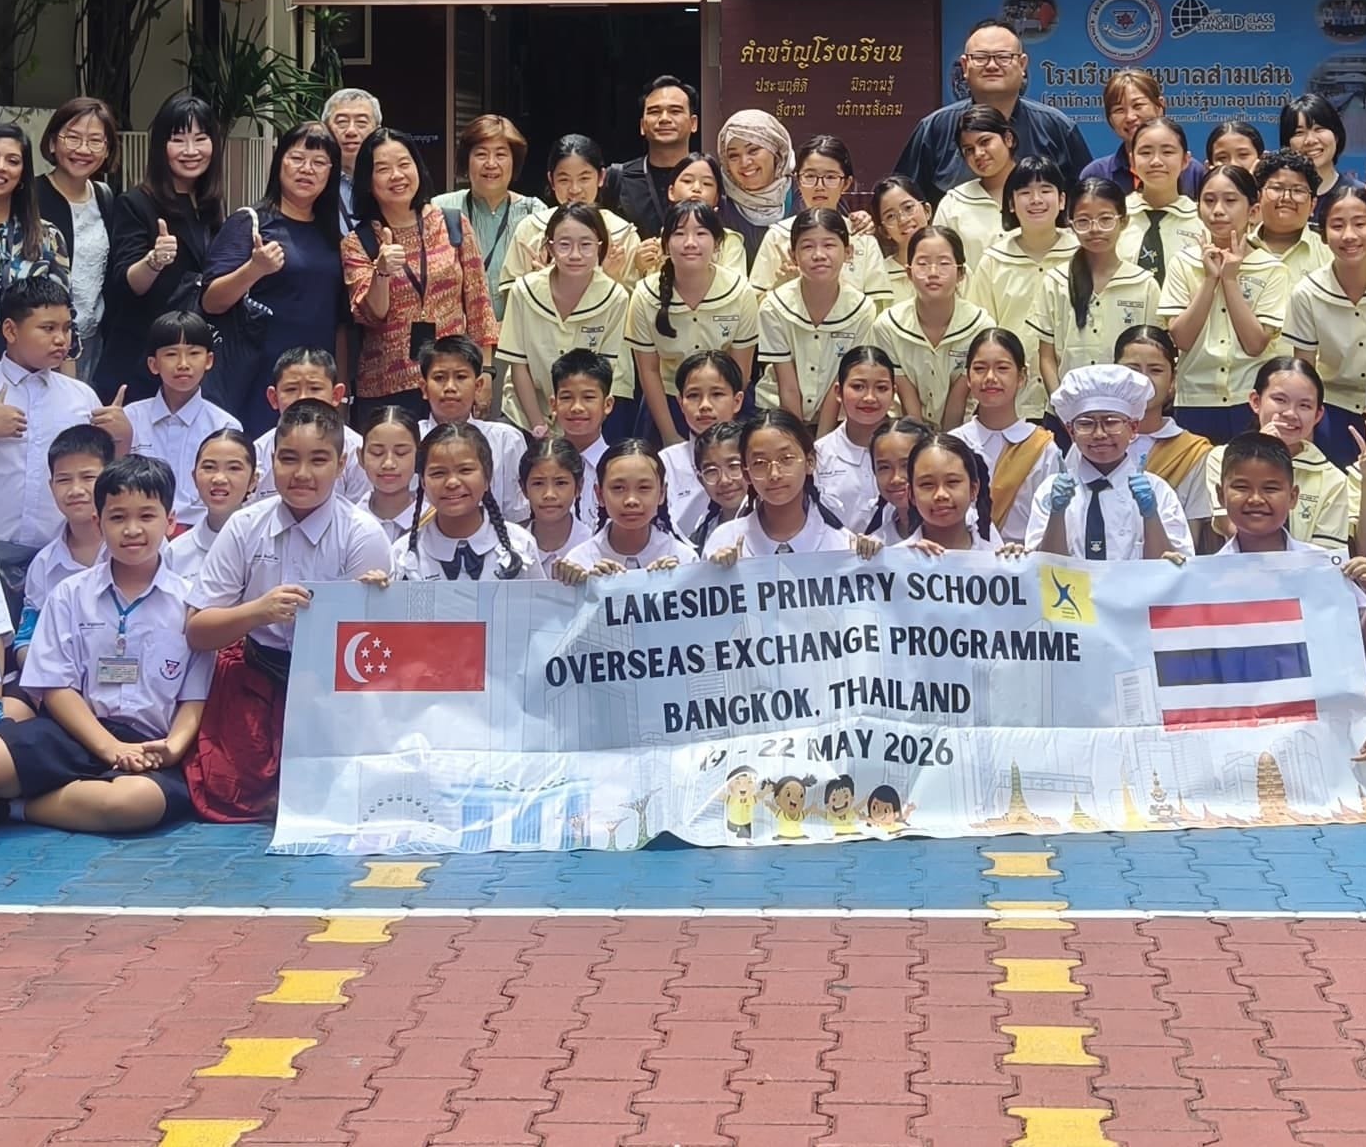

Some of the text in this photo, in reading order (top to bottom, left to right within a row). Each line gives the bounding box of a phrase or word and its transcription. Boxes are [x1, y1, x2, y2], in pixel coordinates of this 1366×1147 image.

[740, 35, 903, 69] คำขวัญโรงเรียน
[604, 571, 1027, 627] LAKESIDE PRIMARY SCHOOL
[544, 624, 1081, 688] OVERSEAS EXCHANGE PROGRAMME
[828, 675, 972, 716] THAILAND
[759, 737, 796, 759] 22
[807, 729, 874, 763] MAY
[883, 731, 954, 767] 2026
